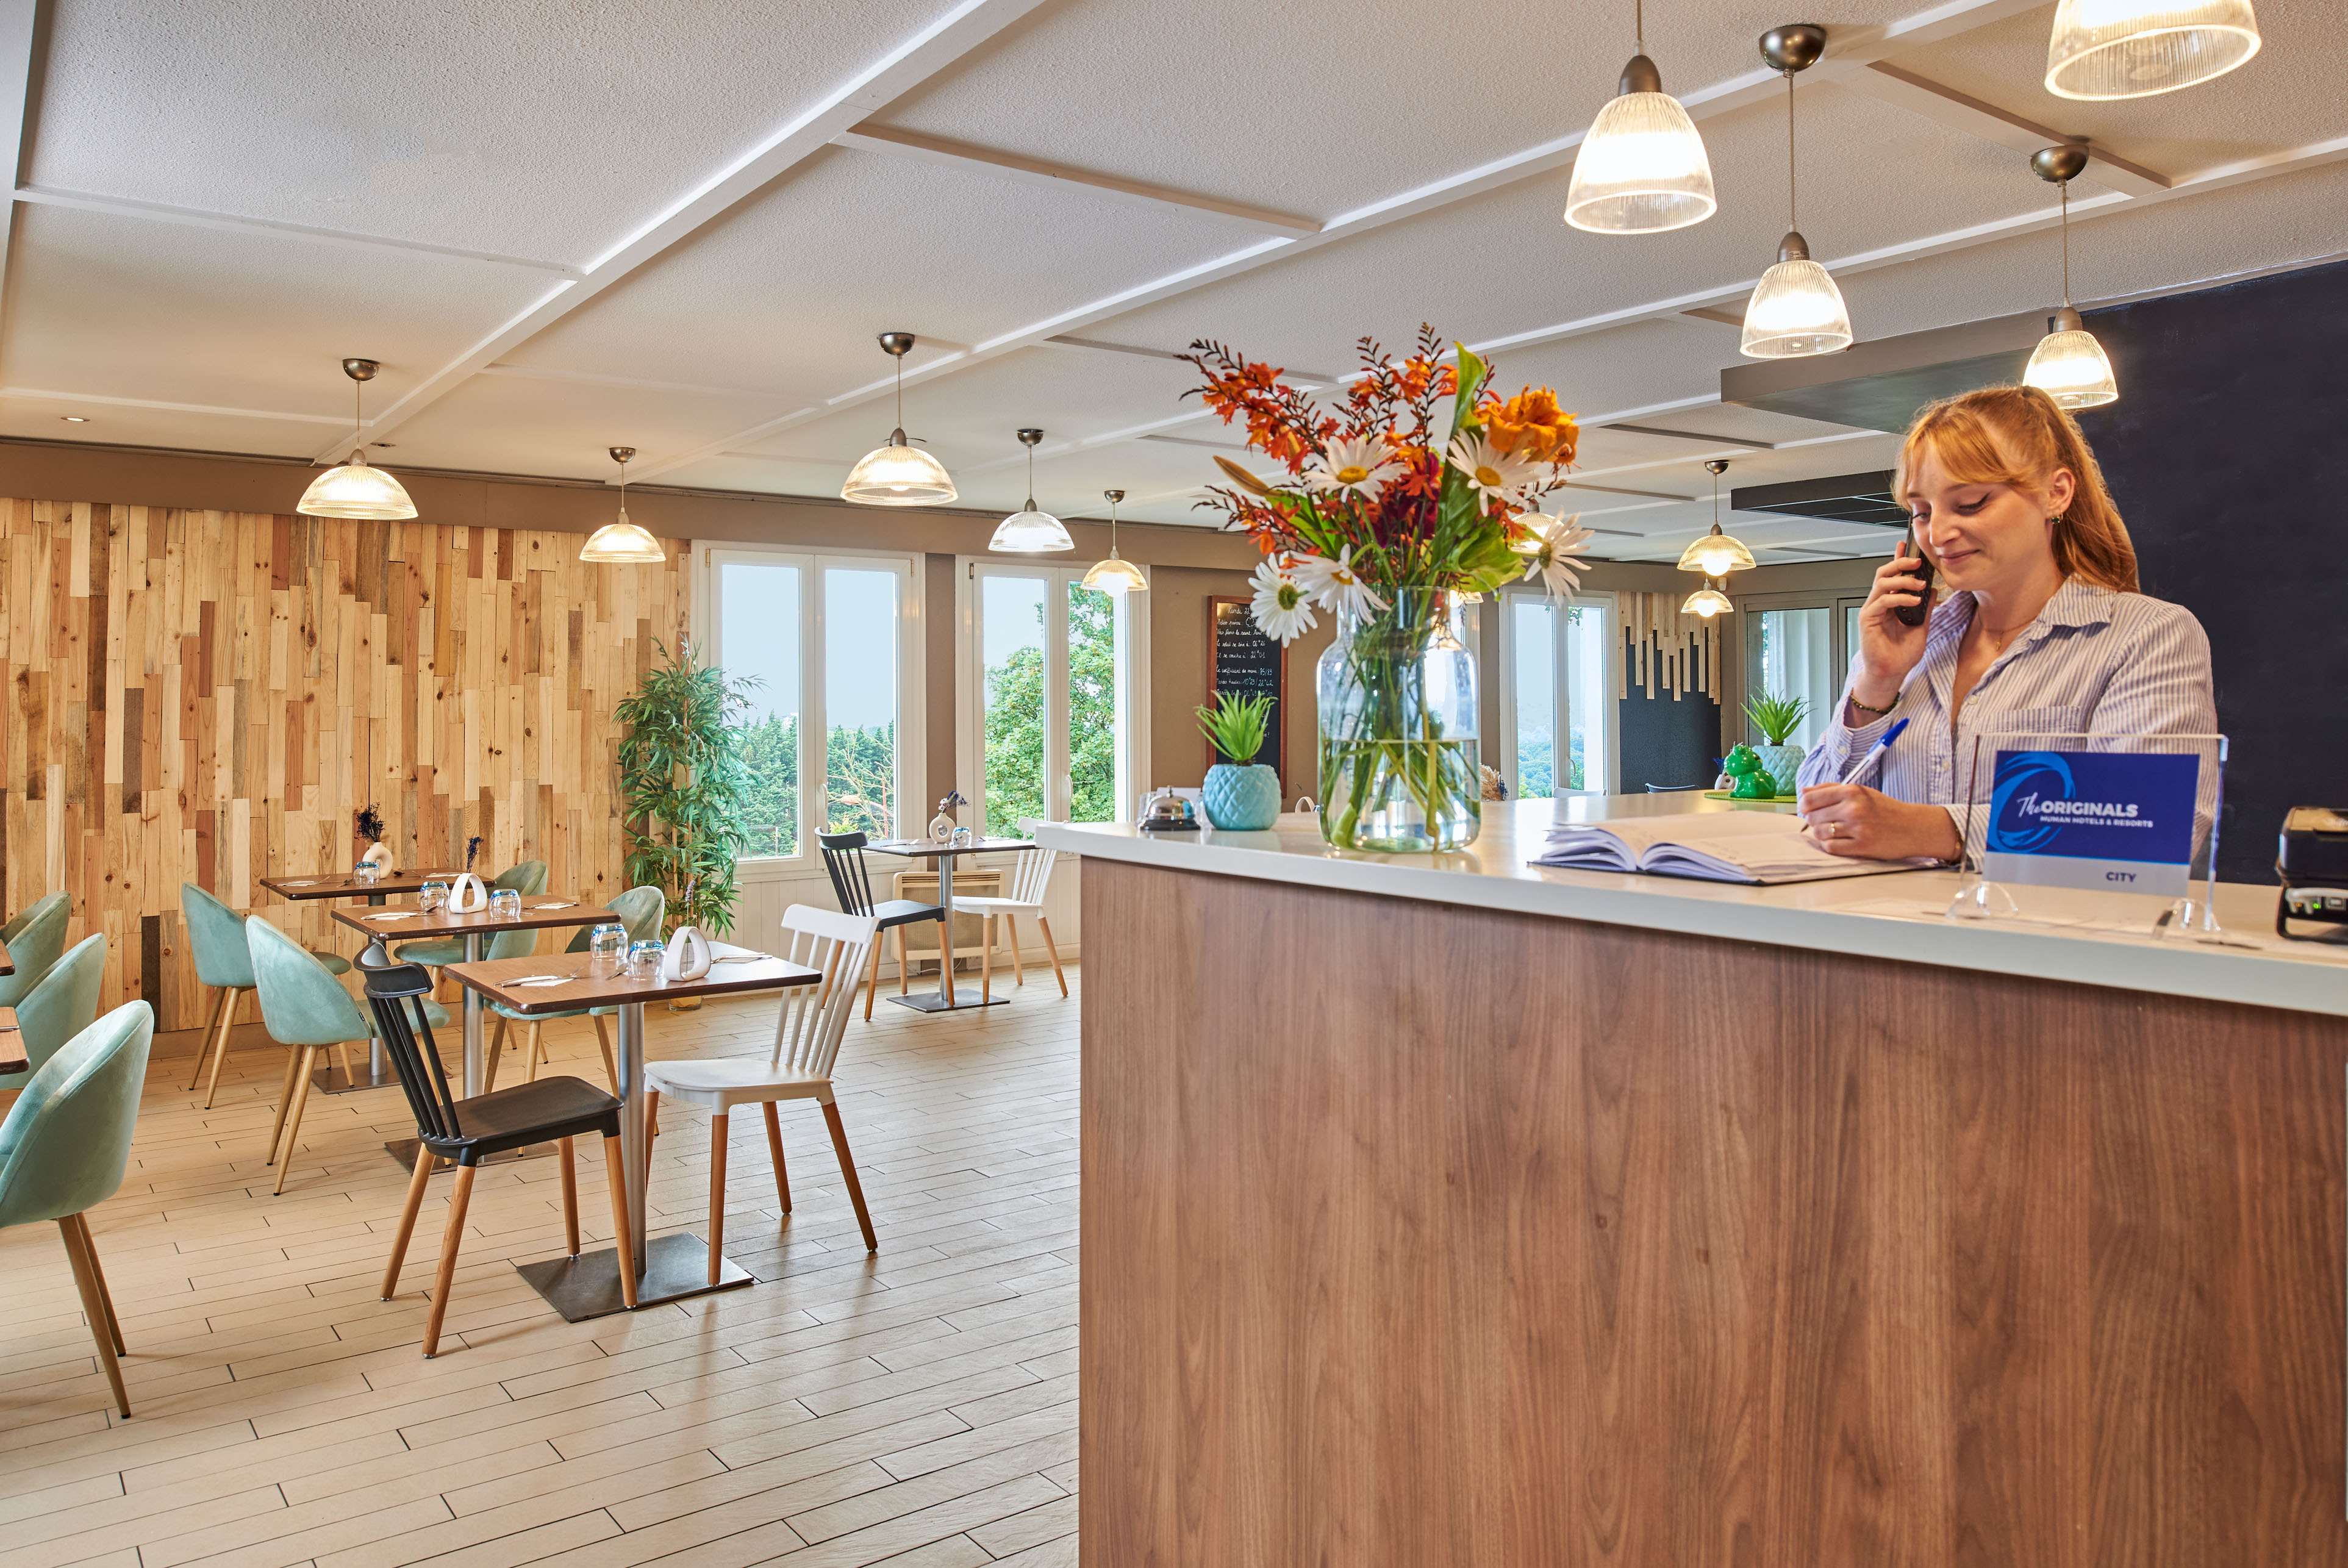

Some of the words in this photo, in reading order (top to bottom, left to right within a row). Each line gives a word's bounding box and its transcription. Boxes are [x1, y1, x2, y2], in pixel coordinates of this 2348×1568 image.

[2016, 792, 2041, 817] The
[2041, 800, 2139, 818] ORIGINALS
[2072, 817, 2105, 826] HOTELS
[2113, 819, 2153, 828] RESORTS
[2106, 871, 2137, 882] CITY
